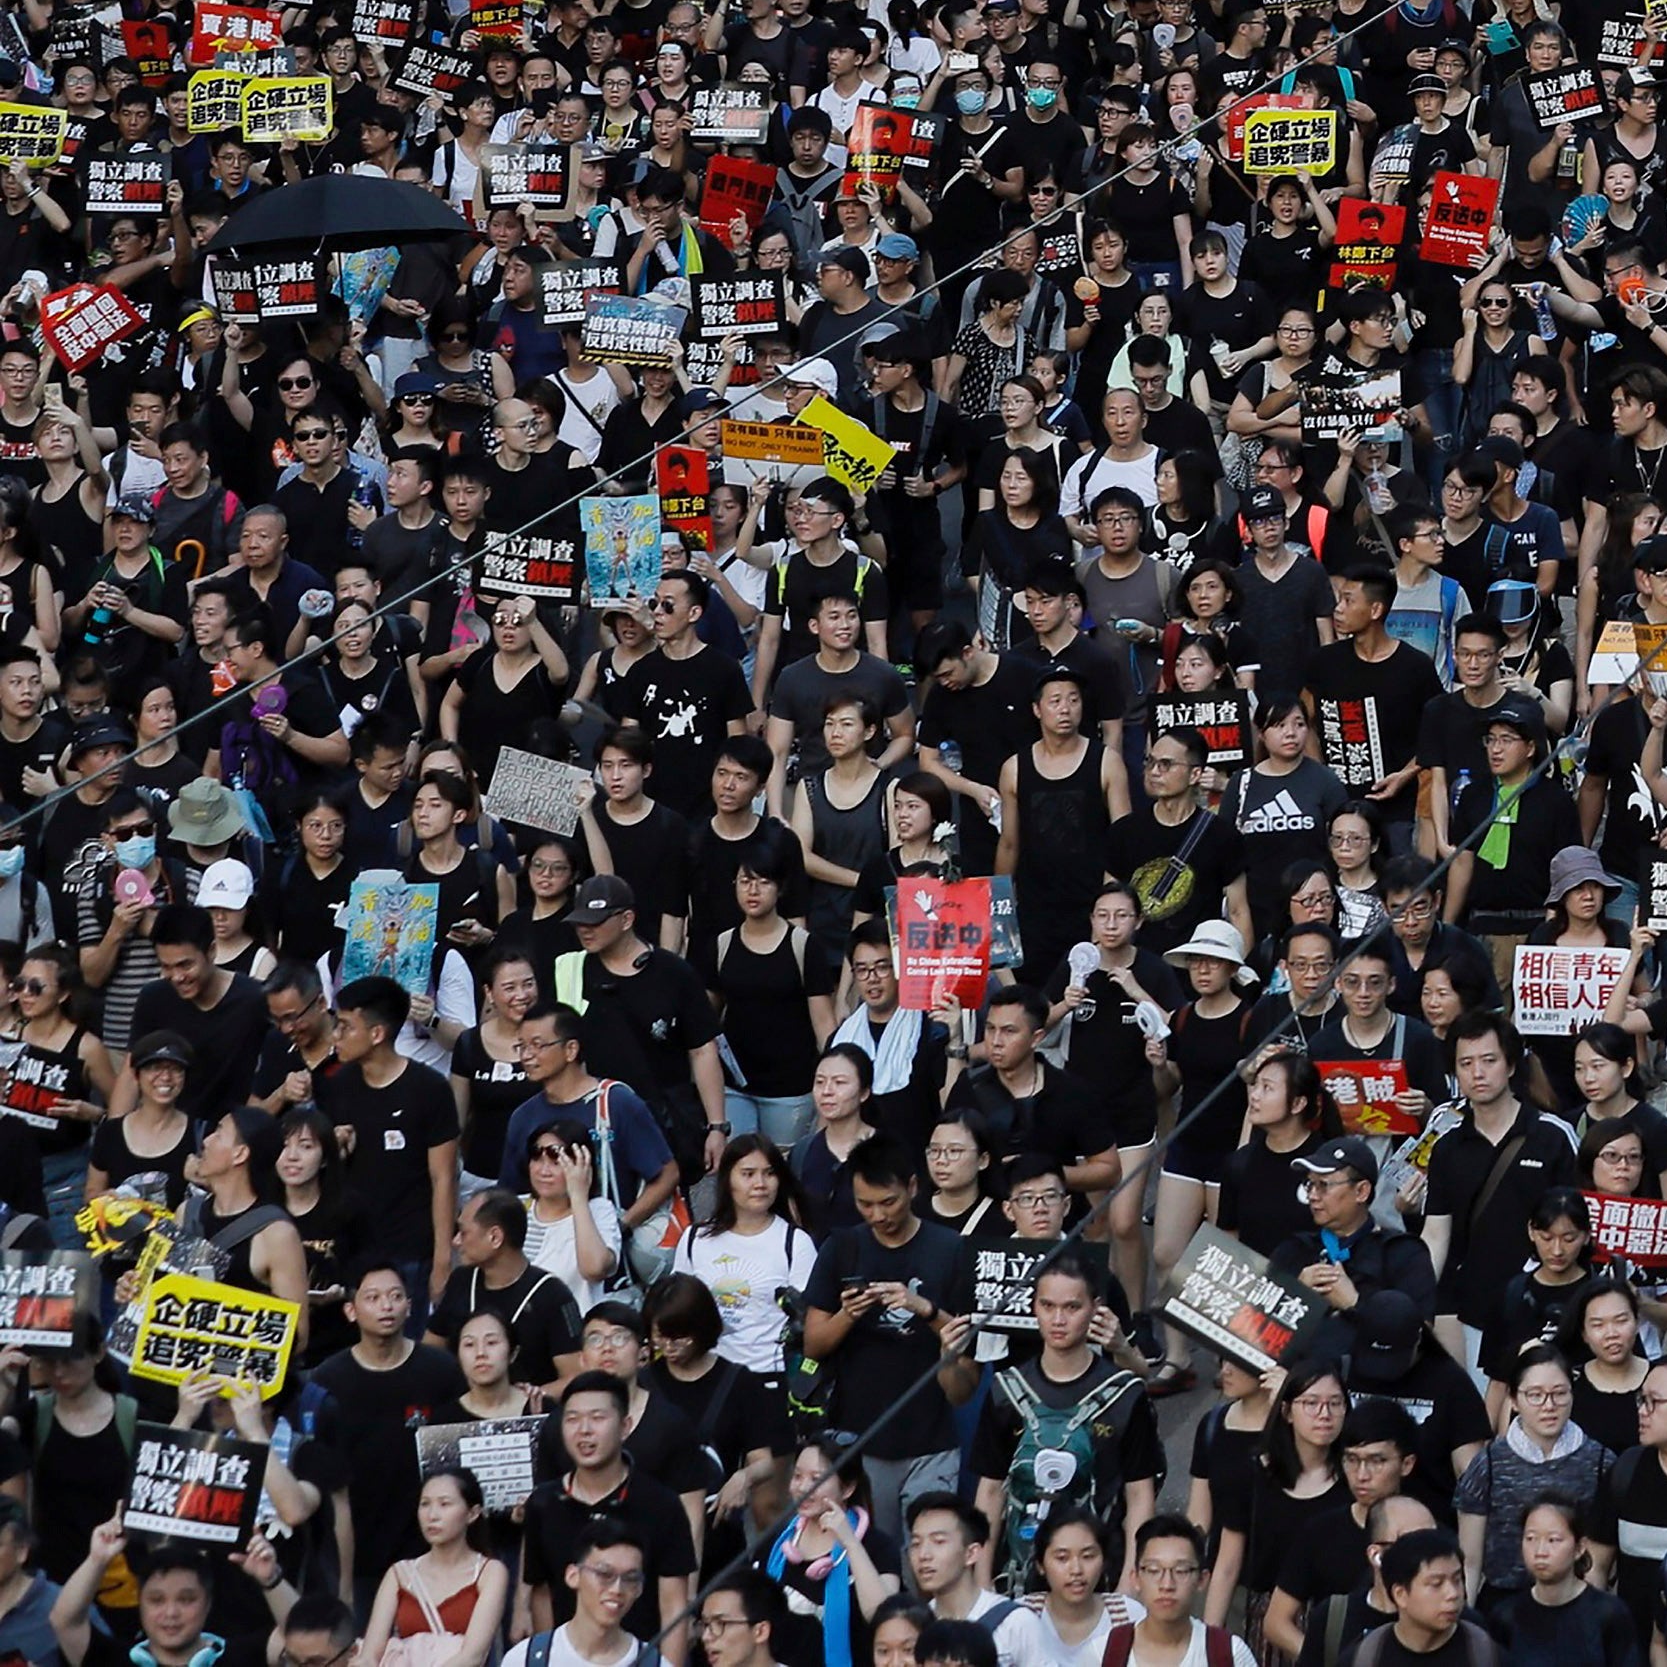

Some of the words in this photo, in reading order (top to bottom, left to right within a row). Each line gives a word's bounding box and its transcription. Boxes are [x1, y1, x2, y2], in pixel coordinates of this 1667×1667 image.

[200, 14, 273, 42] 賣港賊
[248, 86, 328, 108] 企硬立場
[1529, 73, 1593, 99] 獨立調查
[1248, 119, 1329, 142] 企硬立場
[89, 161, 162, 181] 獨立調查
[489, 152, 562, 175] 獨立調查
[1437, 205, 1487, 225] 反送中
[701, 279, 775, 301] 獨立調查
[487, 533, 573, 561] 獨立調查
[1156, 702, 1238, 728] 獨立調查
[518, 753, 569, 775] CANNOT
[1243, 815, 1314, 833] adidas
[1521, 951, 1622, 979] 相信青年
[1197, 1245, 1307, 1327] 獨立調查
[151, 1293, 289, 1345] 企硬立場
[138, 1444, 248, 1481] 獨立調查
